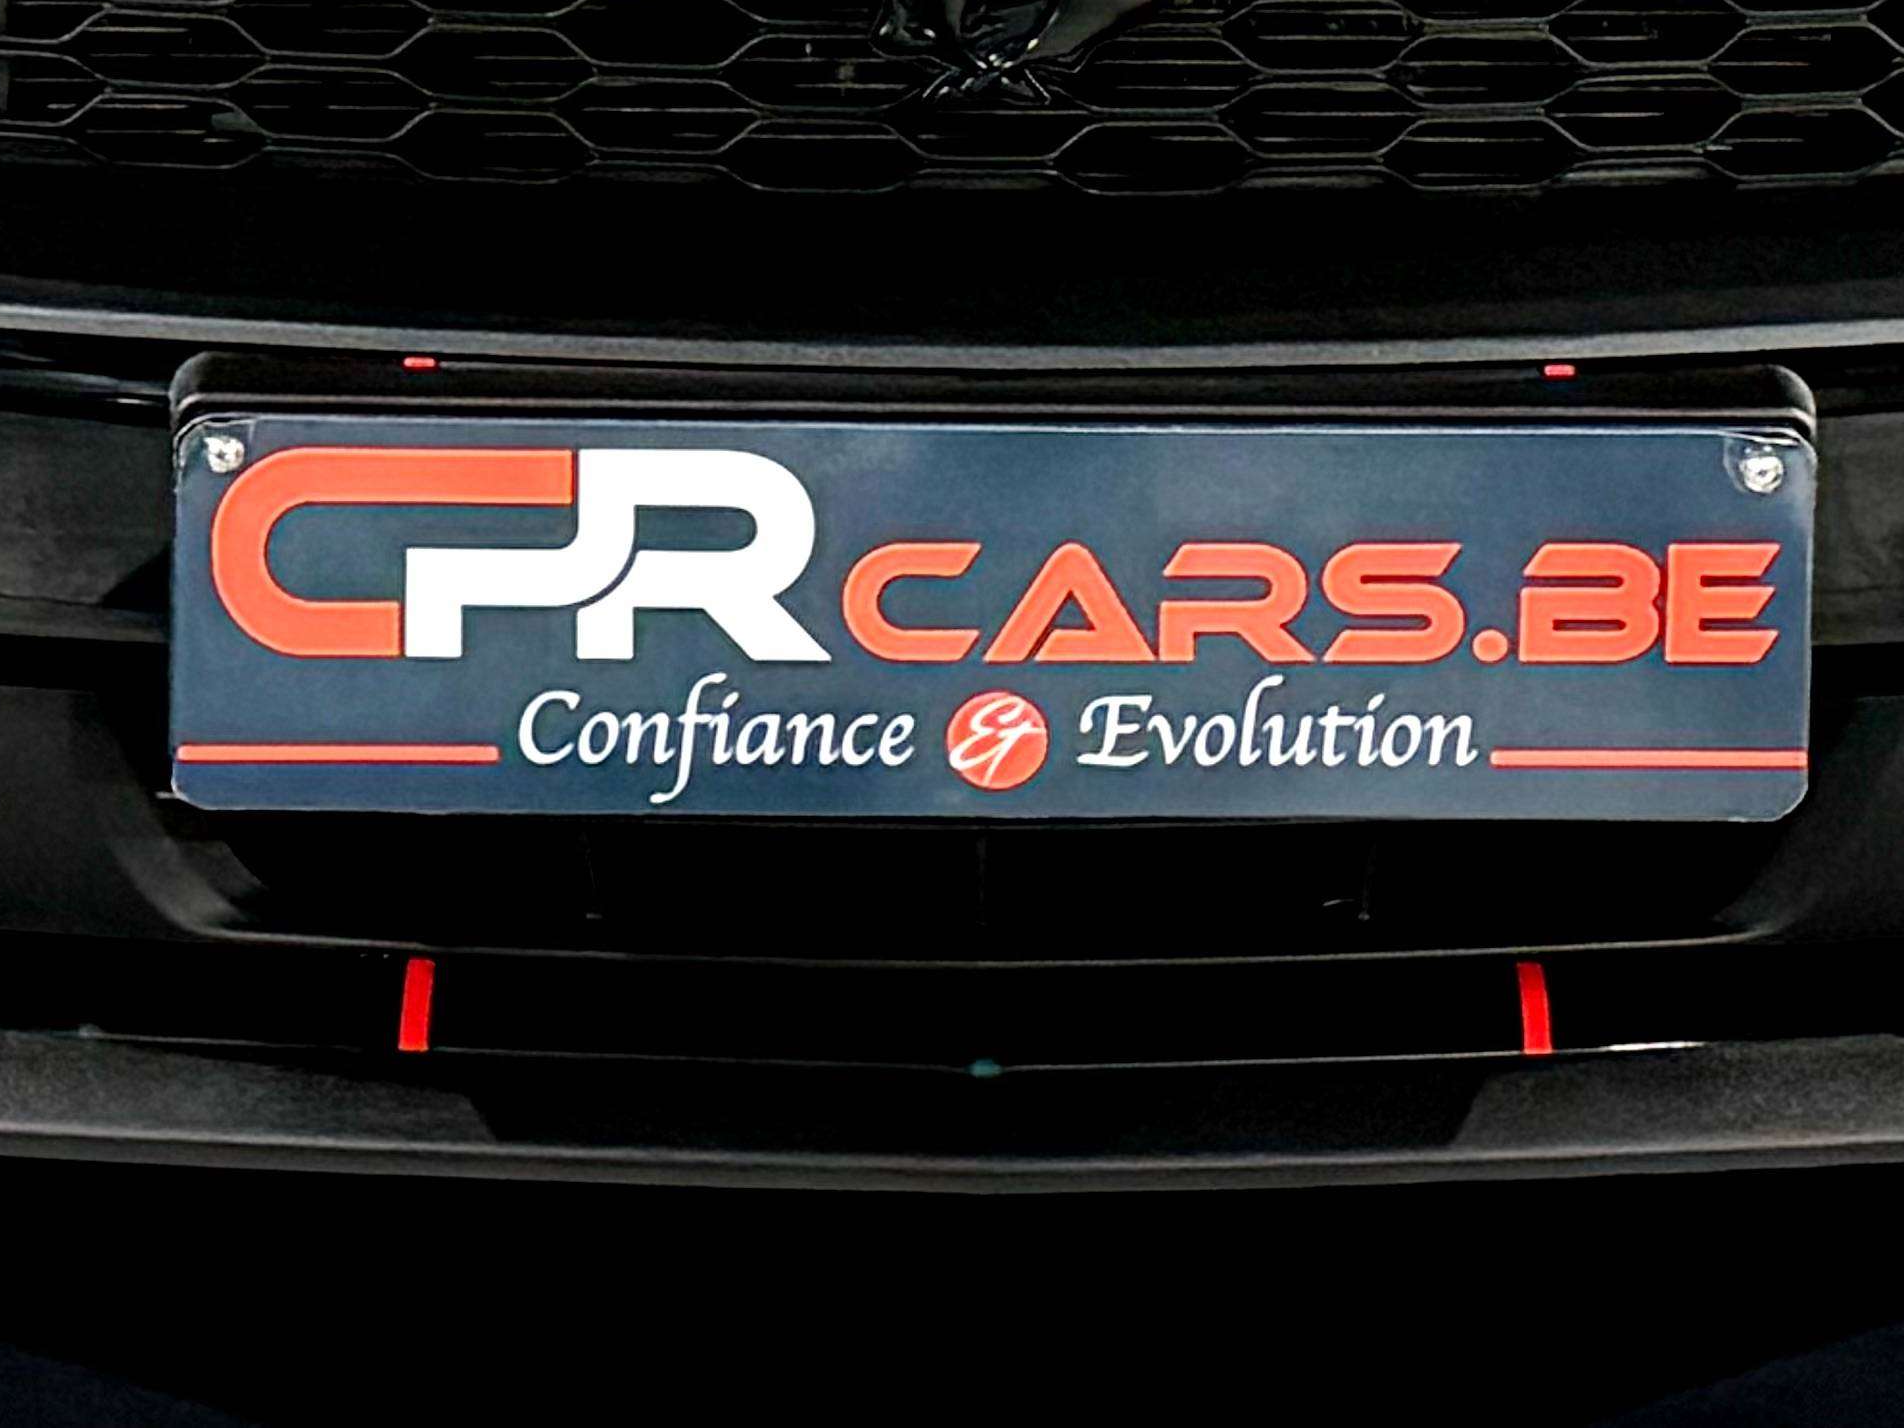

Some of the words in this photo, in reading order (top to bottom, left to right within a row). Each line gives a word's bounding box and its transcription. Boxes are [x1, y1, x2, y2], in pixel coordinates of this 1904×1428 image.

[210, 446, 832, 663] CPR
[842, 541, 1781, 665] CARS.BE
[517, 689, 916, 804] Confiance
[1076, 674, 1480, 768] Evolution
